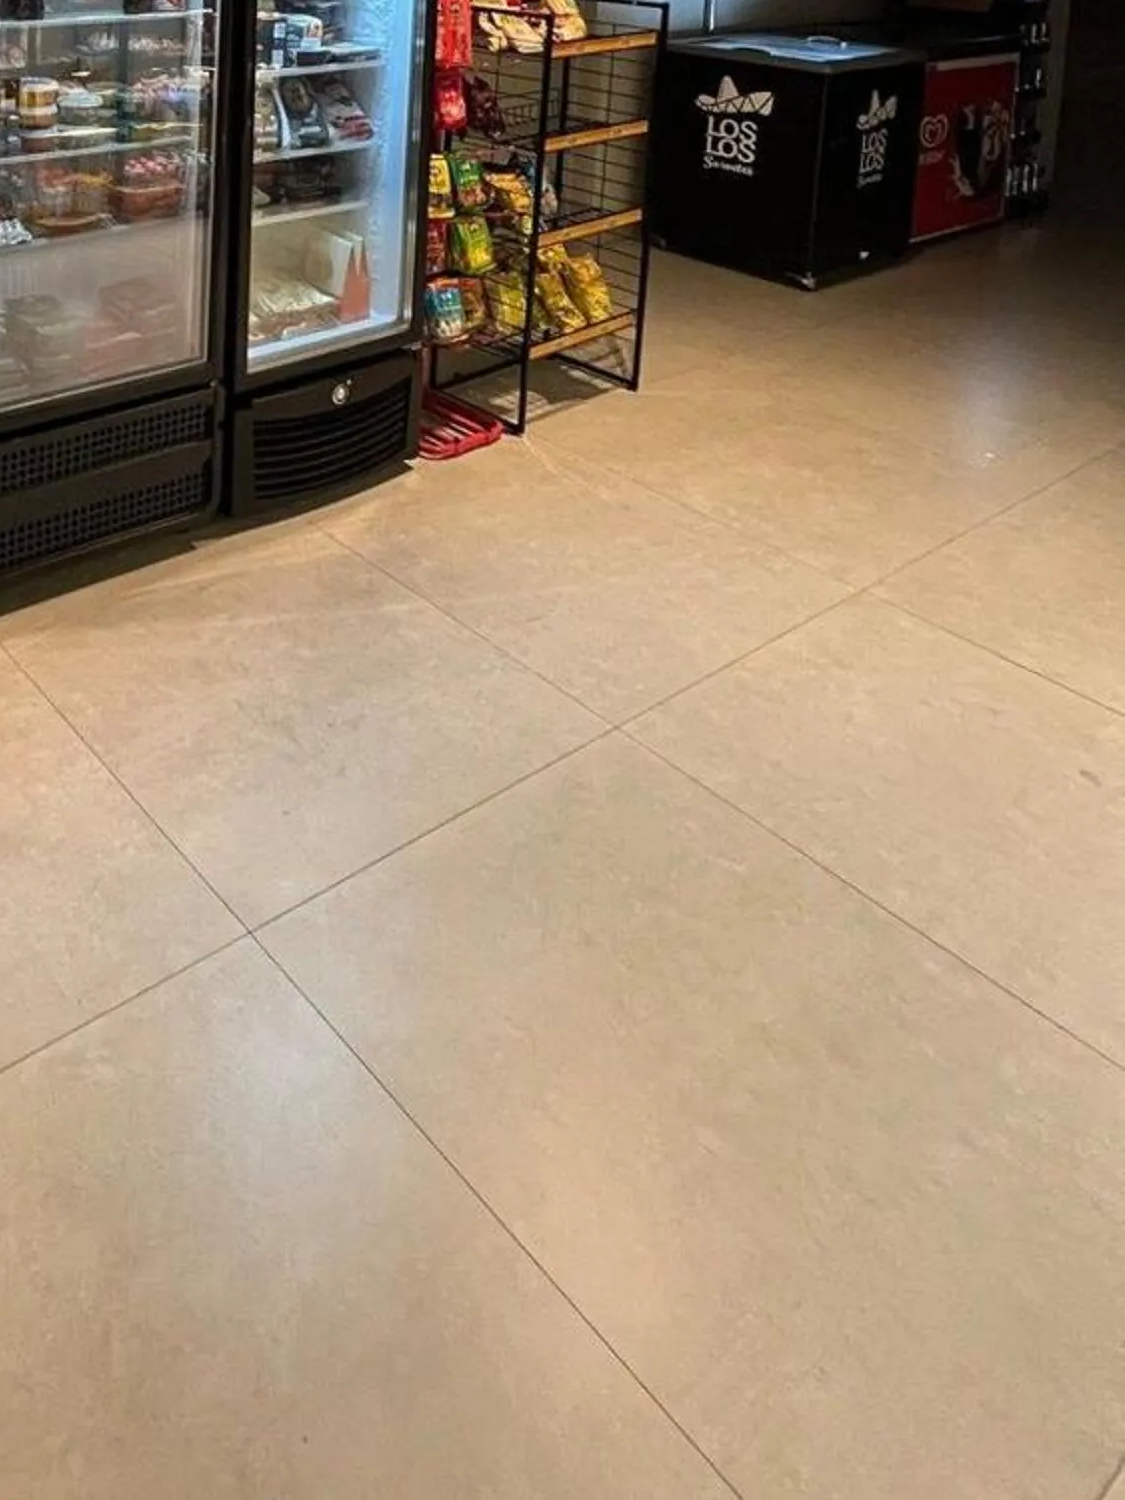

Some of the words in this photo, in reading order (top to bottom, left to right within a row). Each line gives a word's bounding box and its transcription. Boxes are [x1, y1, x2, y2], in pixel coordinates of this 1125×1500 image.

[706, 115, 758, 143] LOS
[860, 128, 888, 154] LOS
[704, 137, 756, 163] LOS
